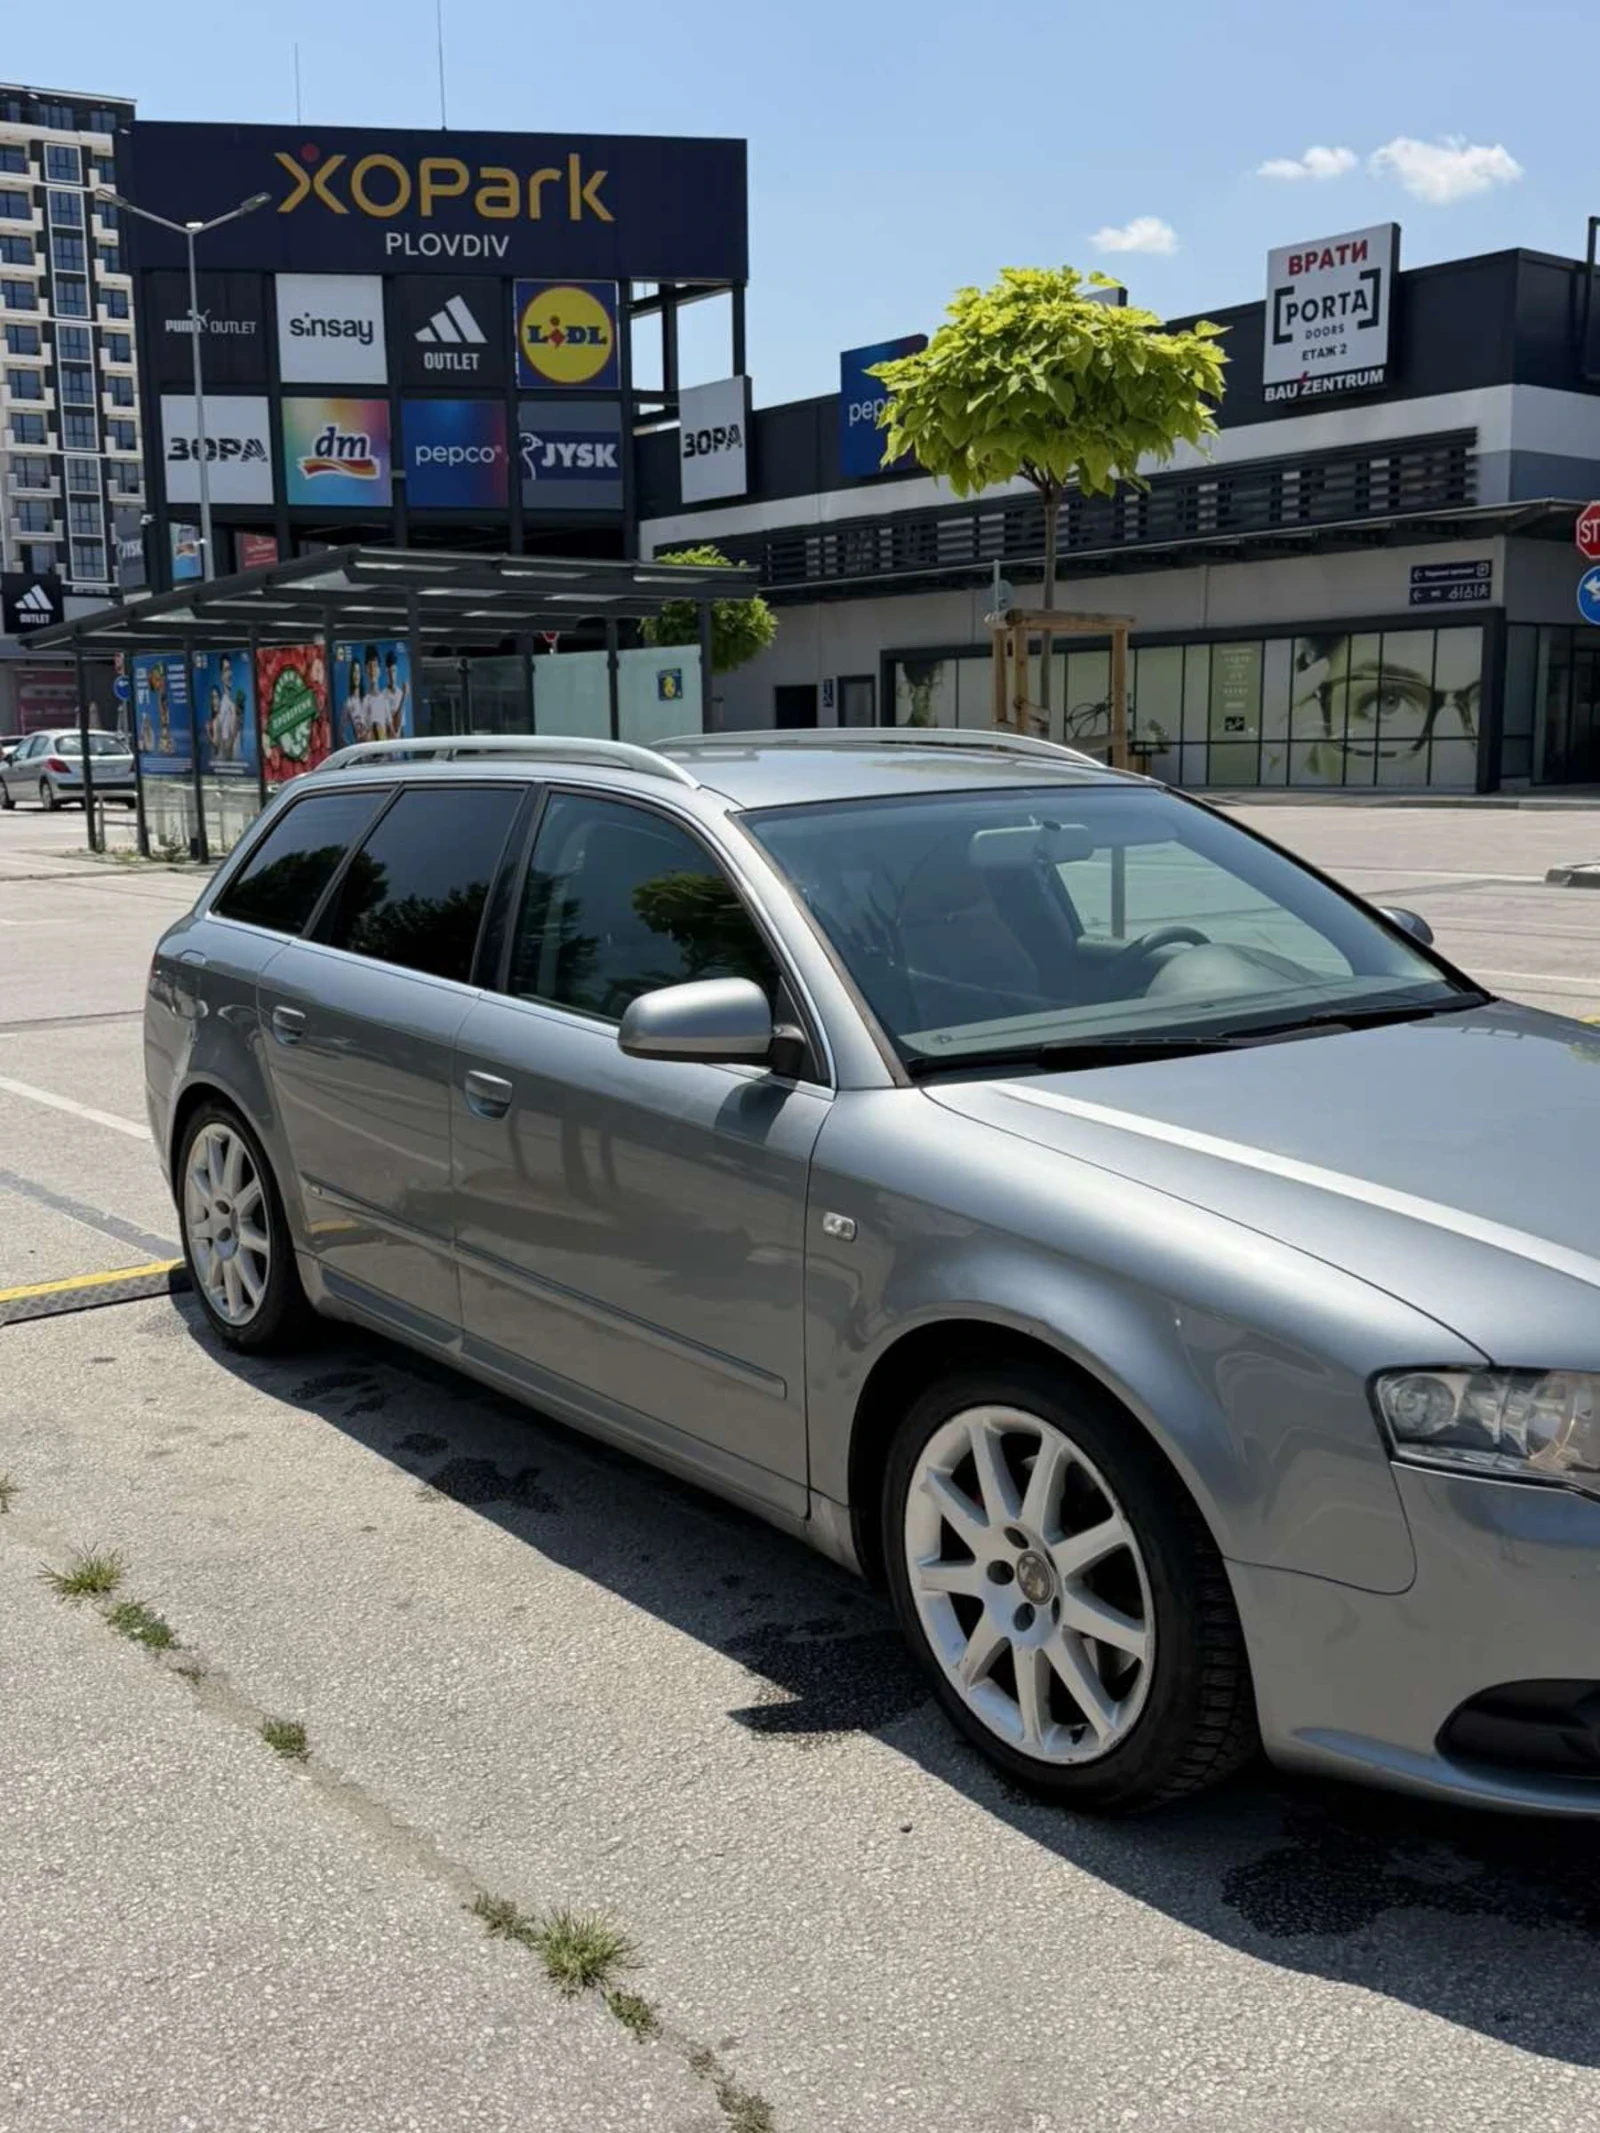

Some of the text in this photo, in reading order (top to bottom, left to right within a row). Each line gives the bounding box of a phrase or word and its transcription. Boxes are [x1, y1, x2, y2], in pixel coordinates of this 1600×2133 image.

[275, 150, 614, 222] XOPark
[385, 233, 511, 258] PLOVDIV
[1288, 240, 1368, 276] ВРАТИ
[1286, 289, 1368, 326] PORTA
[210, 321, 256, 334] OUTLET
[290, 313, 373, 345] sinsay
[1305, 324, 1345, 340] DOORS
[424, 352, 480, 371] OUTLET
[1340, 343, 1347, 355] 2
[1264, 369, 1384, 402] BAU ZENTRUM
[315, 426, 368, 458] dm
[415, 445, 495, 466] pepco
[542, 443, 618, 468] JYSK
